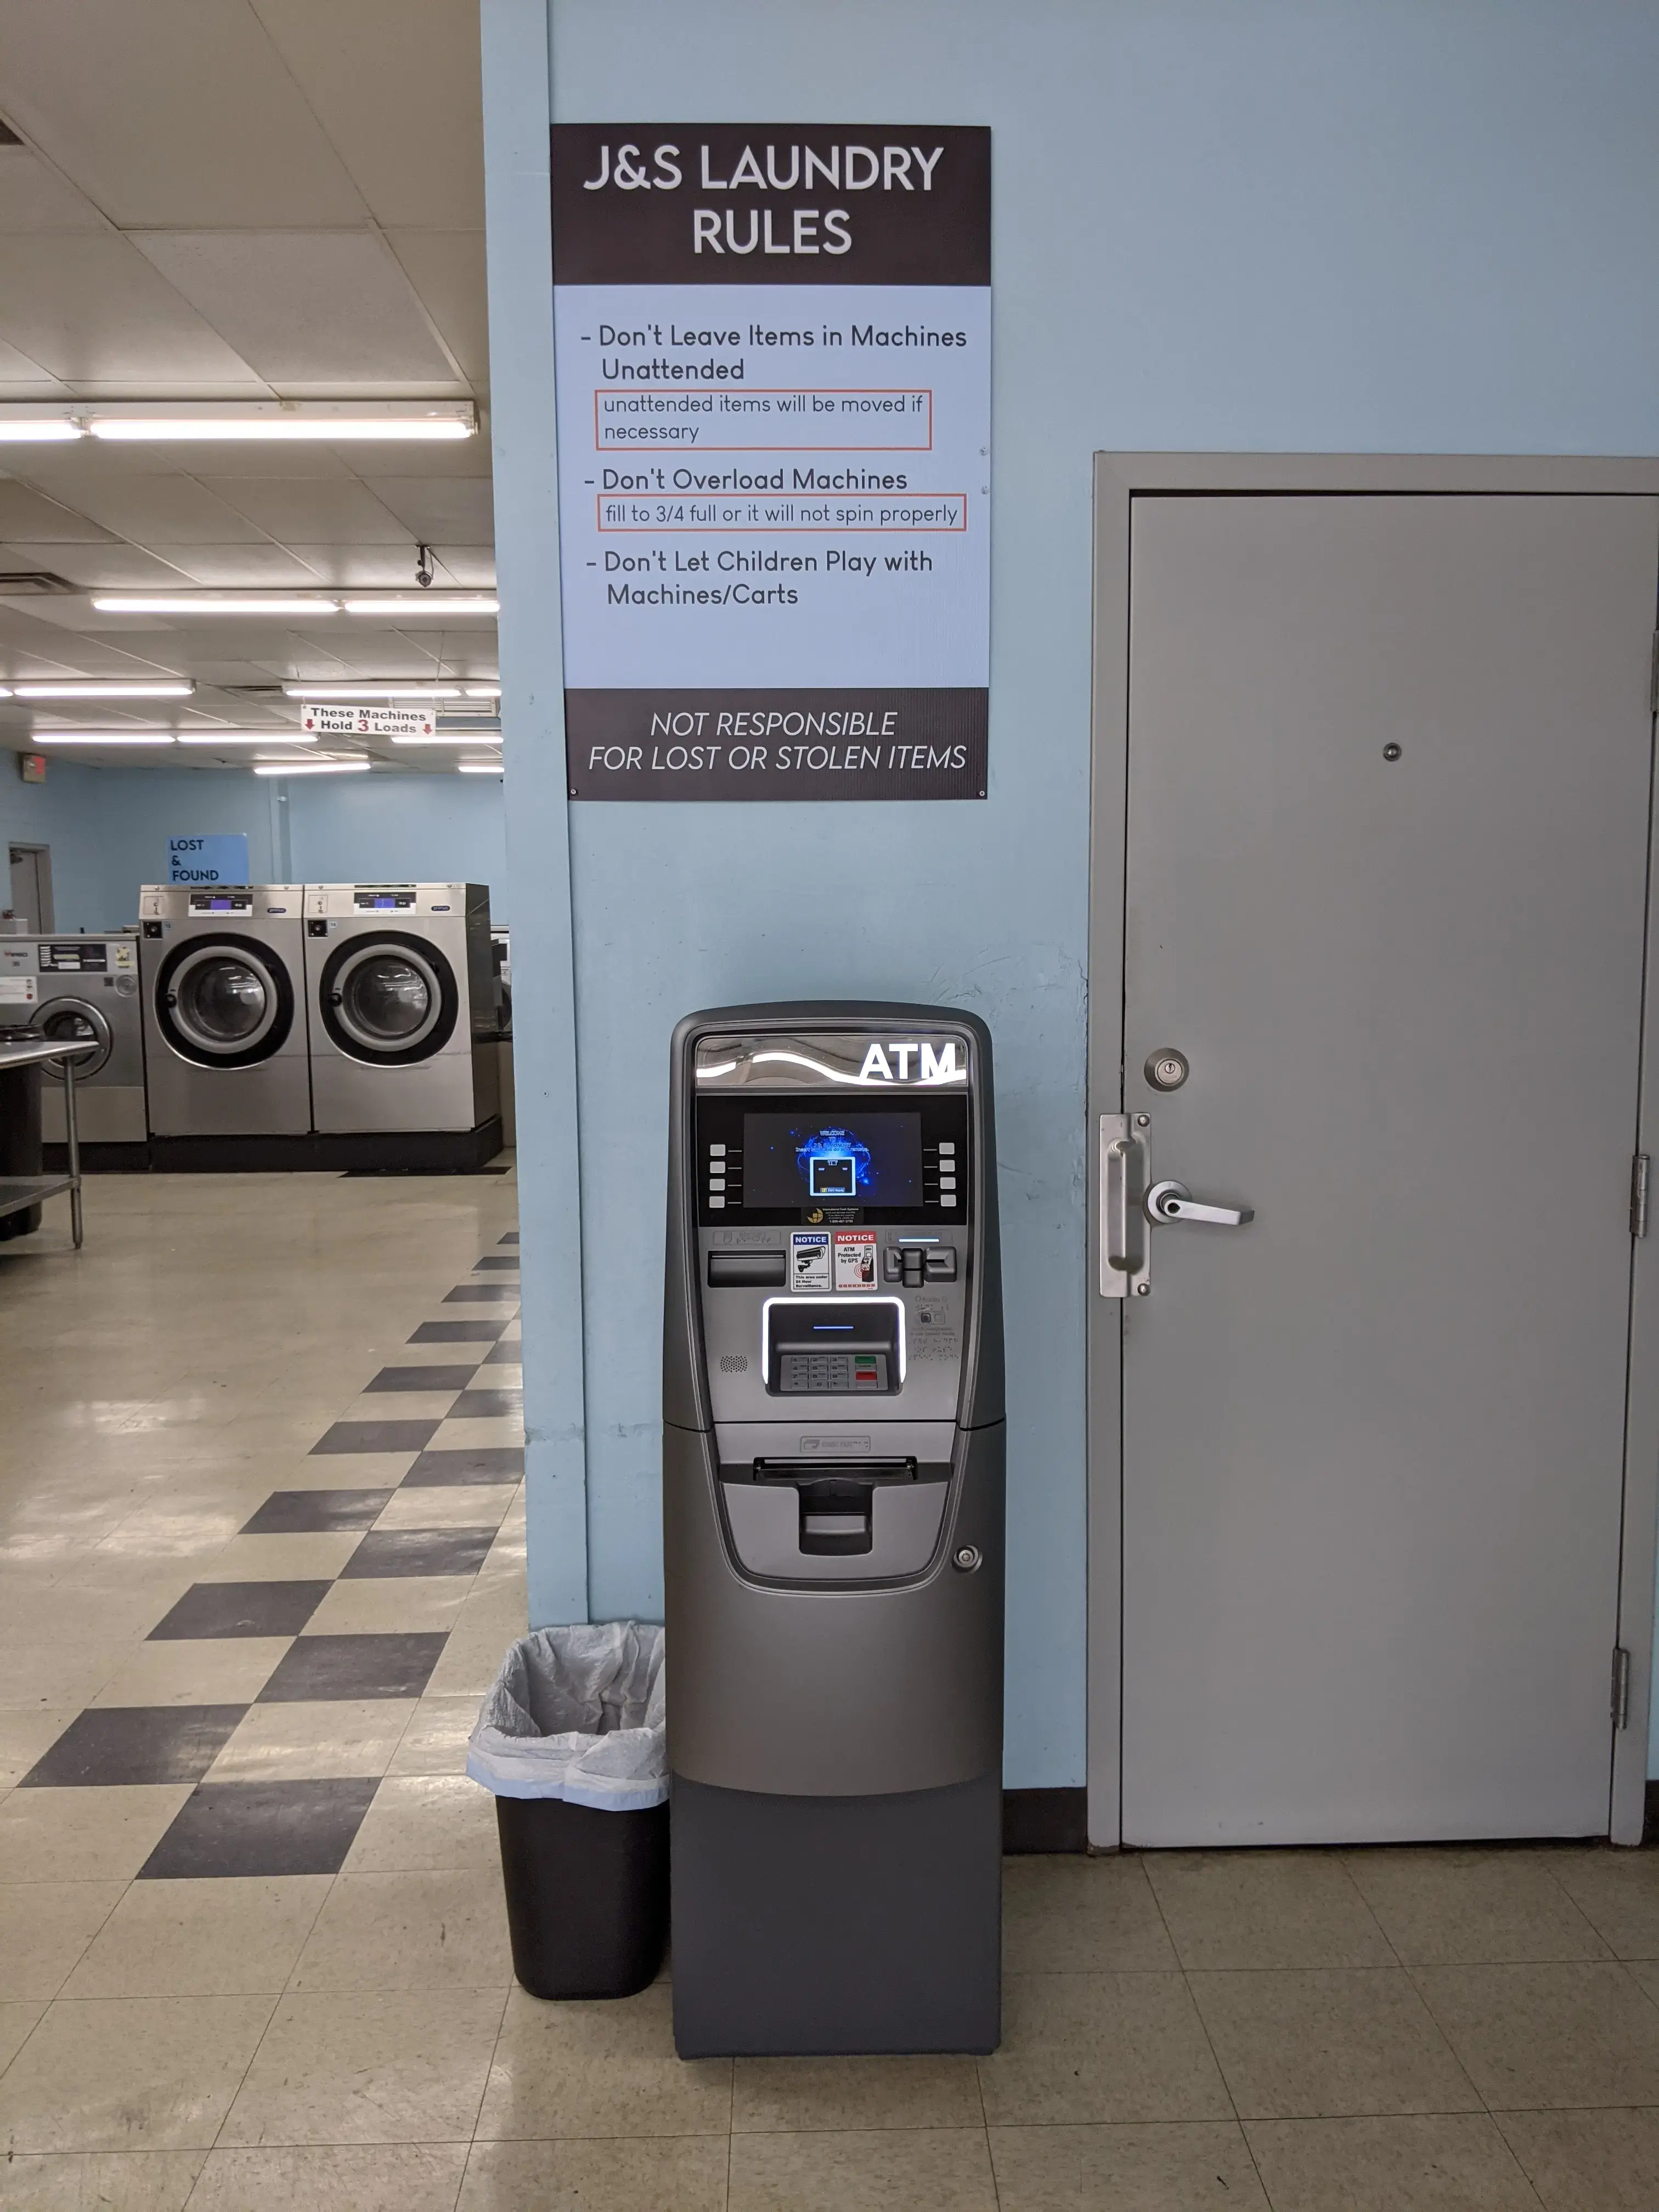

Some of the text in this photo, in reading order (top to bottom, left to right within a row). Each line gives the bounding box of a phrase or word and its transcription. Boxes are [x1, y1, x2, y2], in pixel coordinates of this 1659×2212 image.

[583, 144, 944, 190] J&S LAUNDRY
[694, 210, 851, 254] RULES
[600, 324, 662, 346] Don't
[671, 324, 741, 346] Leave
[749, 324, 815, 346] Items
[823, 324, 842, 346] in
[851, 325, 967, 347] Machines
[602, 358, 744, 380] Unattended
[604, 394, 923, 413] unattended items will be moved if
[605, 427, 699, 444] necessary
[603, 468, 665, 490] Don't
[673, 468, 783, 489] Overload
[793, 468, 907, 489] Machines
[606, 504, 958, 526] fill to 3/4 full or it will not spin properly
[605, 550, 667, 572] Don't
[675, 550, 709, 572] Let
[717, 550, 817, 572] Children
[827, 550, 877, 577] Play
[884, 550, 932, 571] with
[608, 583, 798, 605] Machines/Carts
[311, 707, 426, 721] These Machines
[651, 712, 898, 736] NOT RESPONSIBLE
[321, 719, 416, 733] Hold 3 Loads
[589, 745, 967, 770] FOR LOST OR STOLEN ITEMS
[170, 839, 204, 851] LOST
[171, 855, 182, 866] &
[172, 870, 219, 881] FOUND
[859, 1043, 956, 1074] ATM
